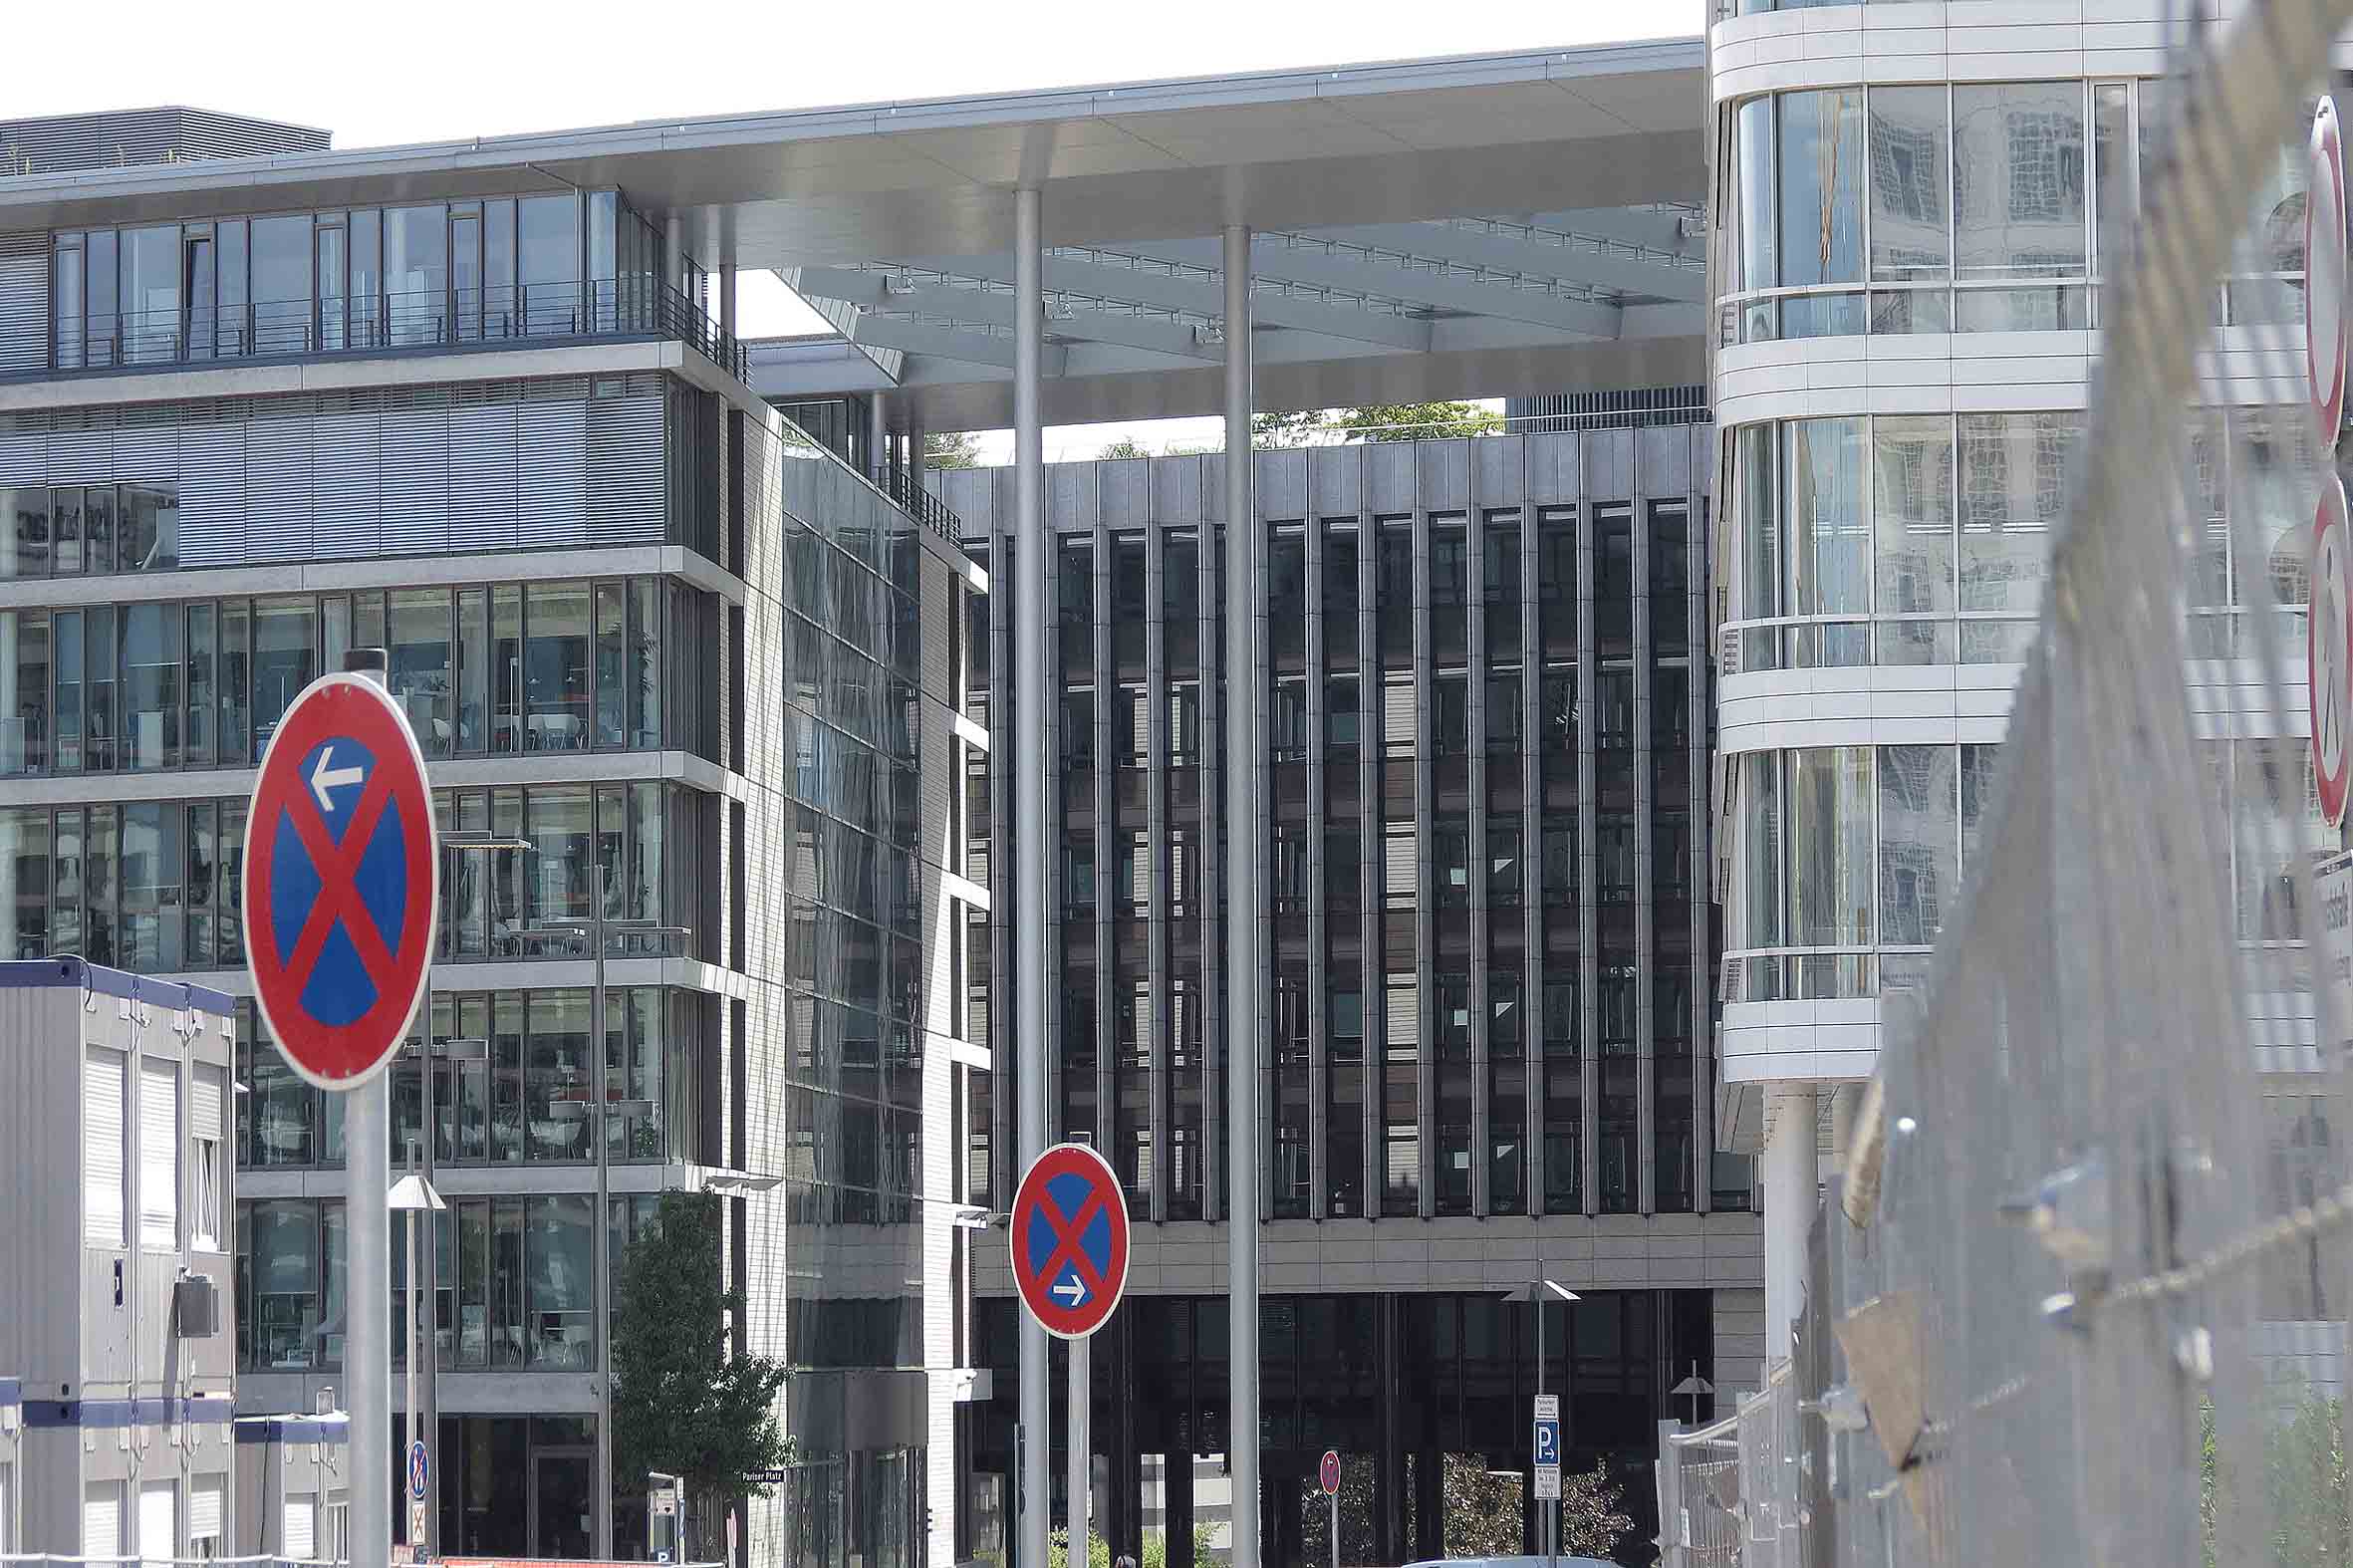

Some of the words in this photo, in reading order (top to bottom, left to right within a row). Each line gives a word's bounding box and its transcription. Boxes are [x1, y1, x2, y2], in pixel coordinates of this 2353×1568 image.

[1538, 1427, 1552, 1458] P
[742, 1471, 765, 1481] Pariser
[765, 1471, 782, 1480] Platz
